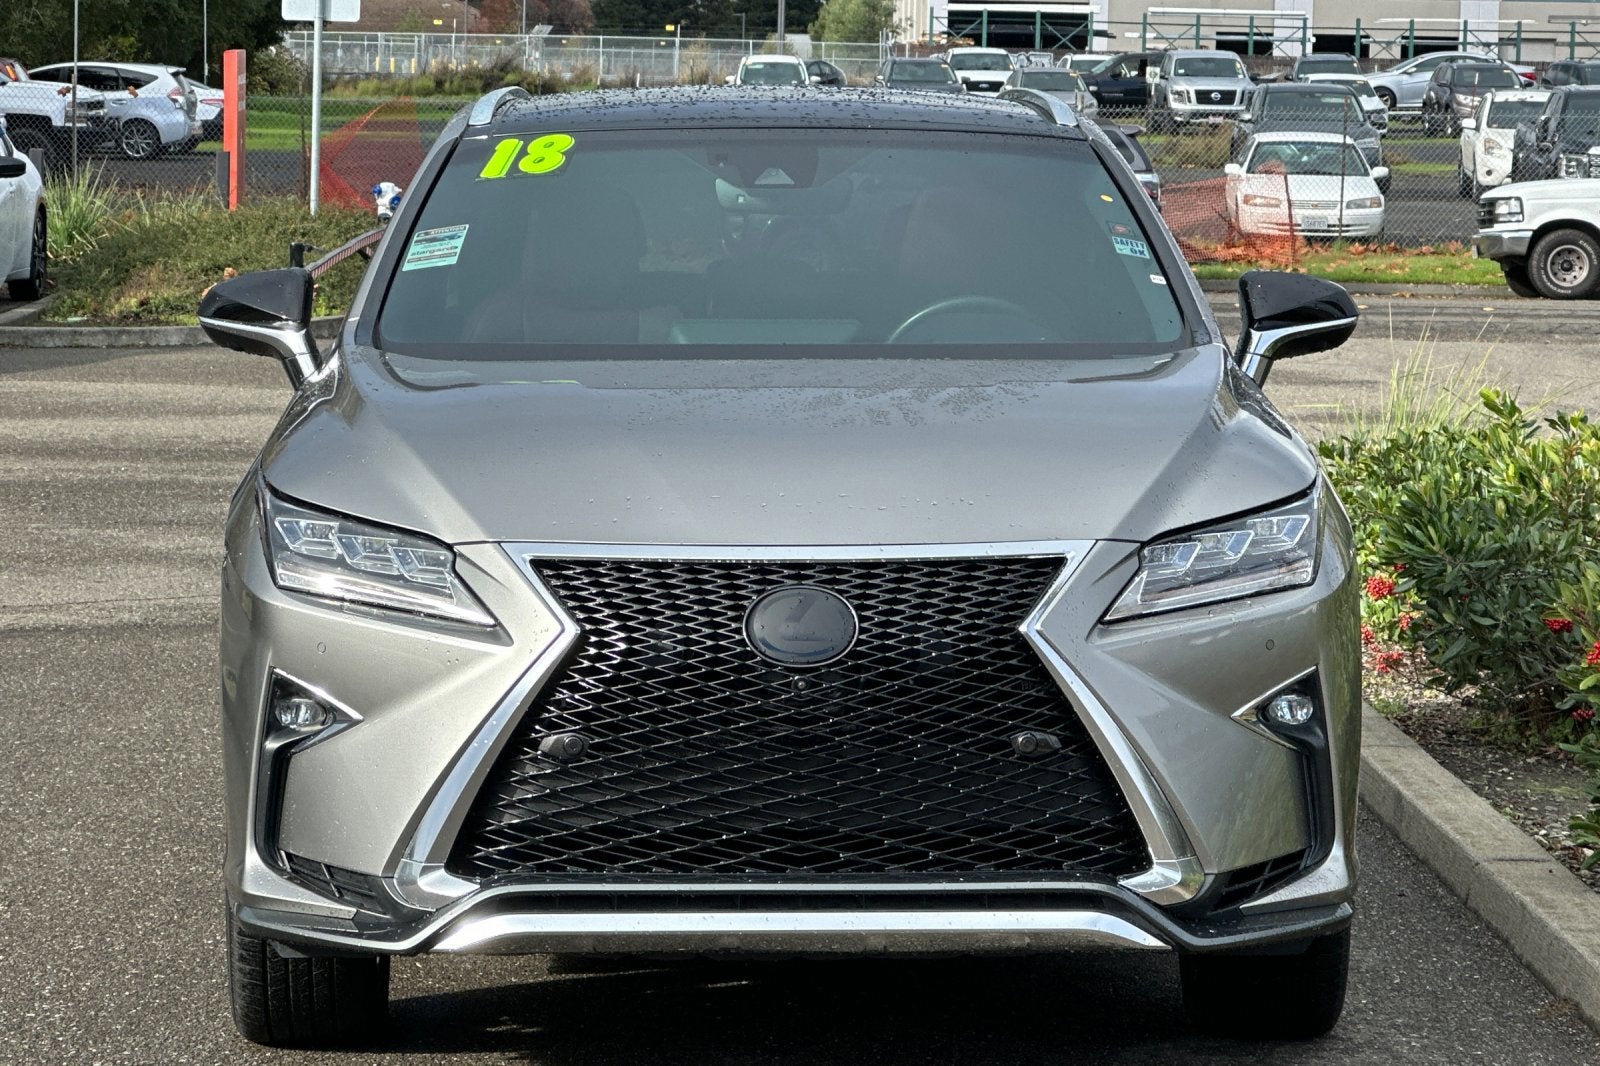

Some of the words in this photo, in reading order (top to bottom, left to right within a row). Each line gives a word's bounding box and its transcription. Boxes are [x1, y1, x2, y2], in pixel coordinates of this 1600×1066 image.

[479, 133, 575, 178] 18
[1113, 237, 1145, 249] SAFETY
[1130, 247, 1146, 256] OK
